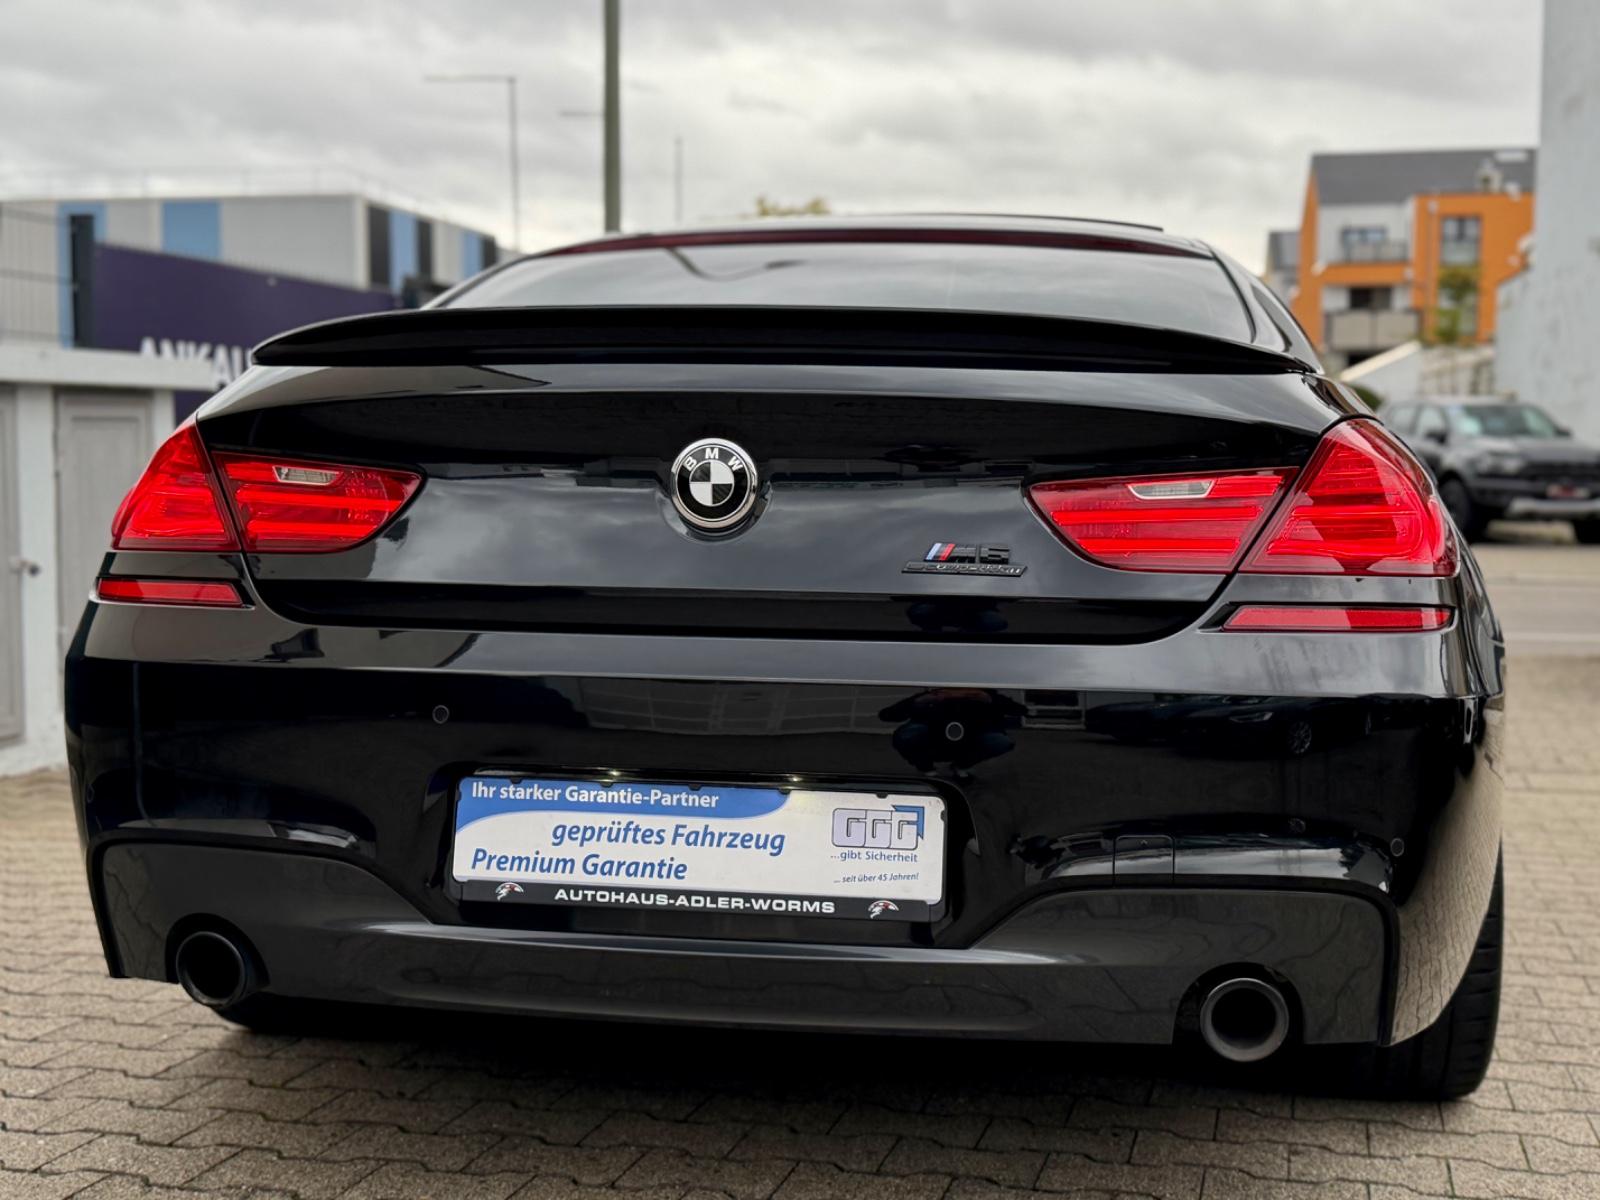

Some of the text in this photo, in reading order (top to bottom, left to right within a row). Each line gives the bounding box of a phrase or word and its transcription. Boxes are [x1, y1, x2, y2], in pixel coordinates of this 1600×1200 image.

[682, 447, 744, 472] BMW
[472, 781, 720, 809] Ihr starker Garantie-Partner
[551, 820, 786, 857] geprüftes Fahrzeug
[471, 848, 688, 880] Premium Garantie
[865, 850, 919, 863] Sicherheit
[878, 872, 889, 881] 45
[554, 888, 836, 914] AUTOHAUS-ADLER-WORMS
